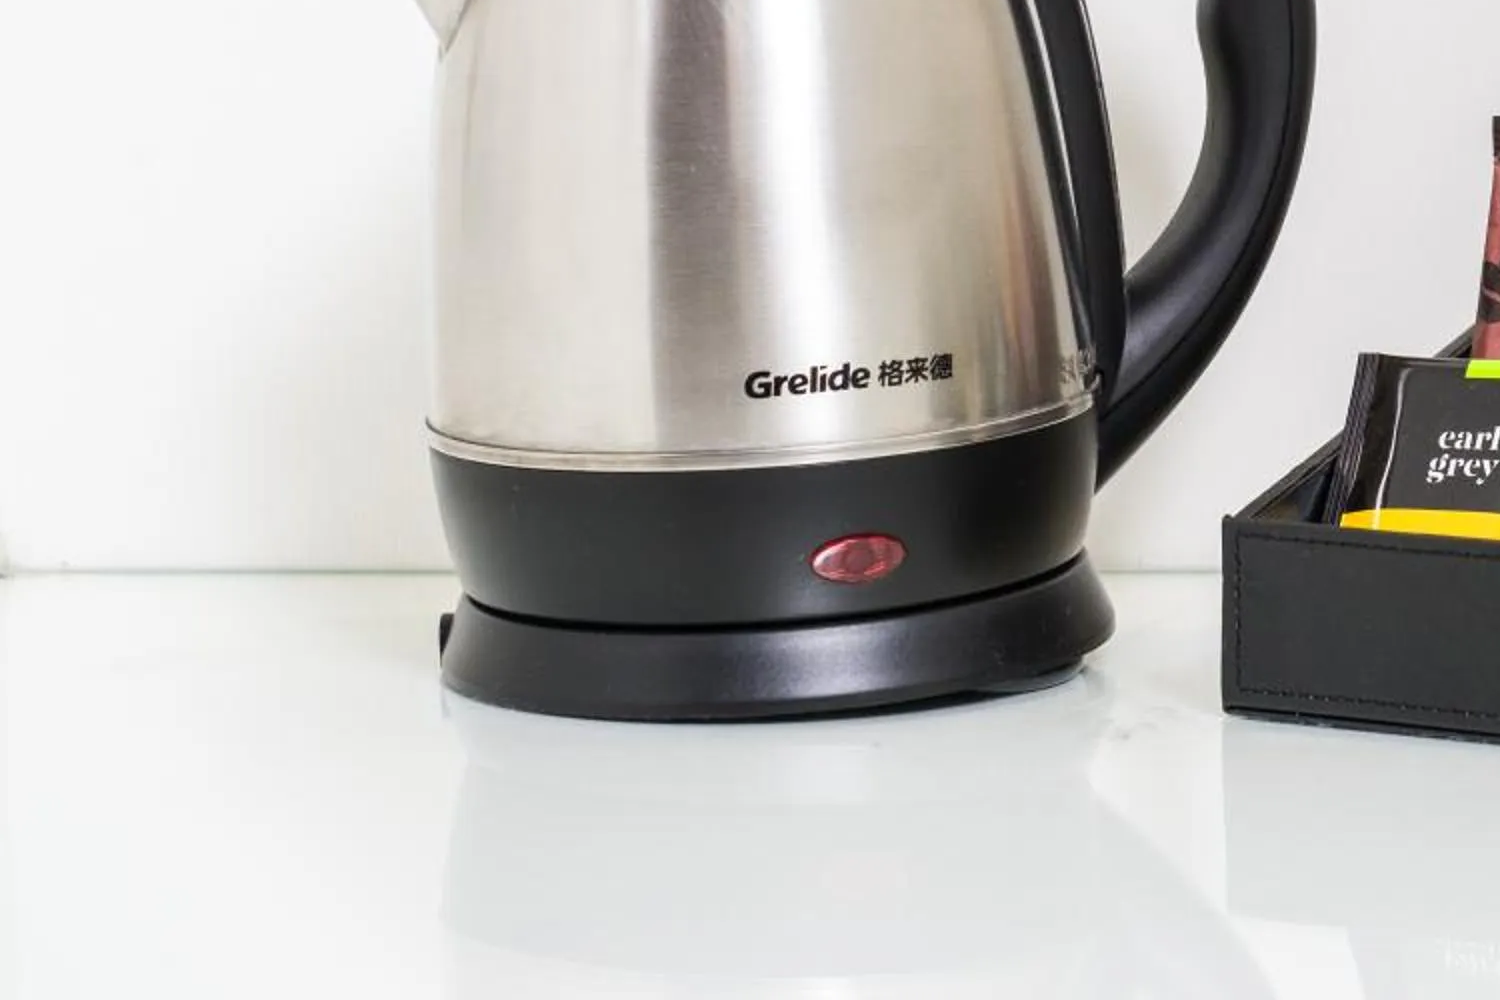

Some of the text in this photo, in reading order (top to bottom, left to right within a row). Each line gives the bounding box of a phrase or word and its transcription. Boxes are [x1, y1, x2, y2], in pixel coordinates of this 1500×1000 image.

[744, 353, 953, 399] Grelide 格来德
[1425, 453, 1500, 485] grey
